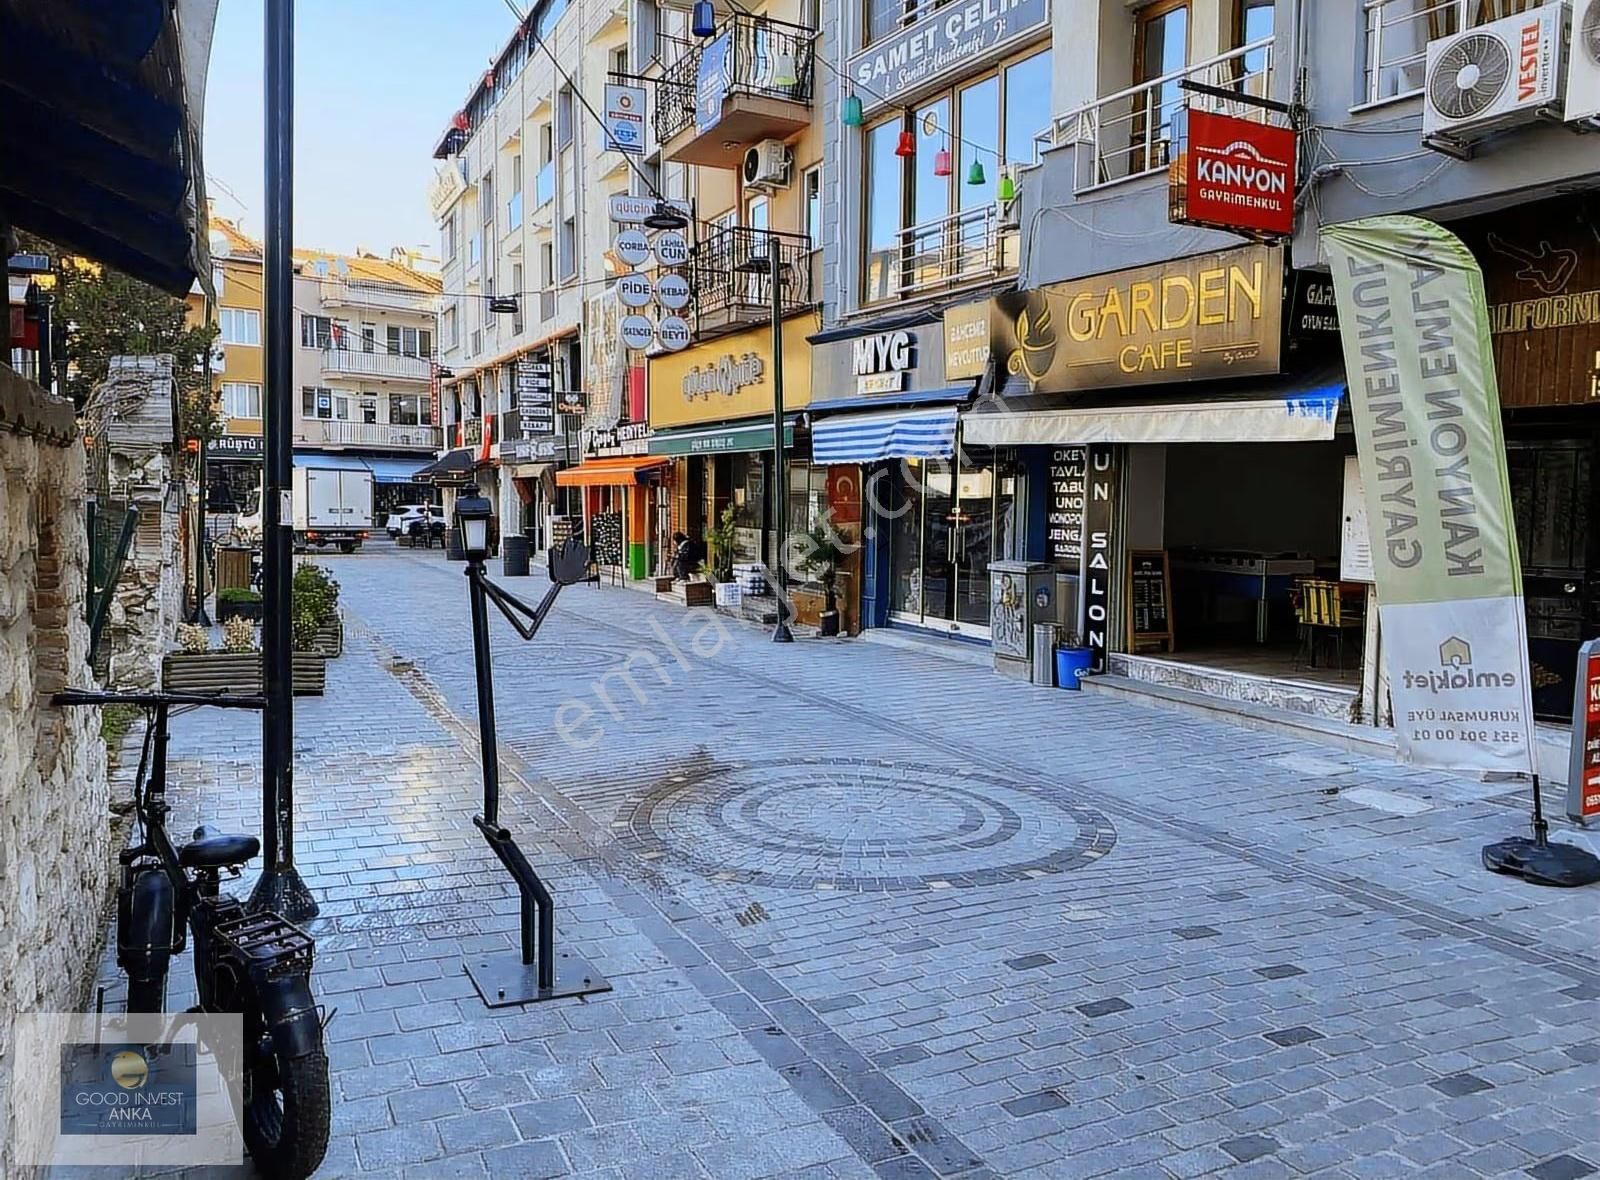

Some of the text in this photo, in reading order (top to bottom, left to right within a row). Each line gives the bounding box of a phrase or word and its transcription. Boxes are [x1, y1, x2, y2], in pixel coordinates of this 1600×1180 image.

[857, 25, 938, 85] SAMET
[1518, 18, 1540, 101] VESTEL
[1197, 156, 1286, 194] KANYON
[1199, 187, 1283, 212] GAYRİMENKUL
[660, 248, 686, 260] CUN
[621, 280, 650, 295] PİDE
[1067, 262, 1263, 343] GARDEN
[661, 328, 689, 341] BEYTİ
[852, 330, 910, 376] MYG
[1118, 338, 1194, 374] CAFE
[219, 437, 256, 453] RÜŞTÜ
[1055, 496, 1083, 509] UNO
[1048, 529, 1082, 541] JENG
